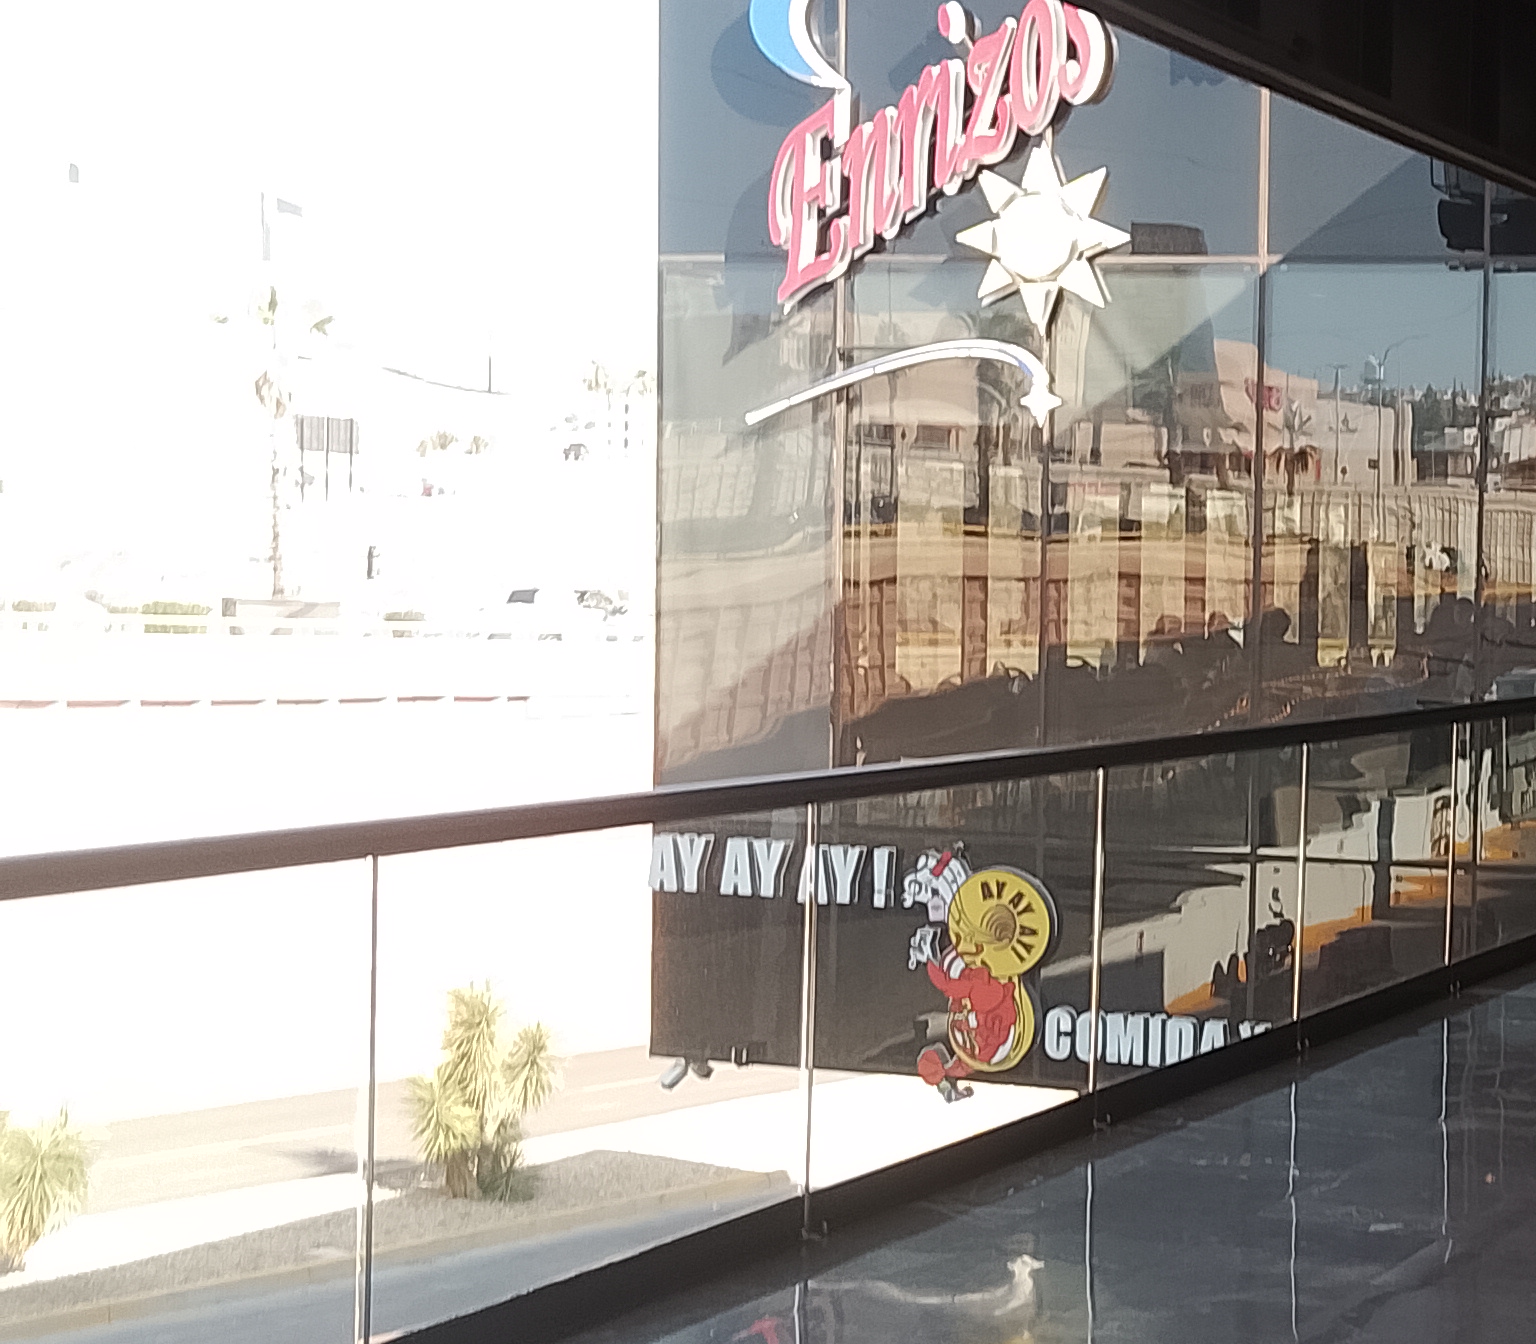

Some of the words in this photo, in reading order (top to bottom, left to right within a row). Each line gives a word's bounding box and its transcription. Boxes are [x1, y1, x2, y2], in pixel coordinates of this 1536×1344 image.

[649, 832, 715, 894] AY
[720, 836, 794, 898] AY
[980, 878, 1007, 902] AY
[1008, 889, 1035, 916] AY
[1045, 1005, 1230, 1067] COMIDA
